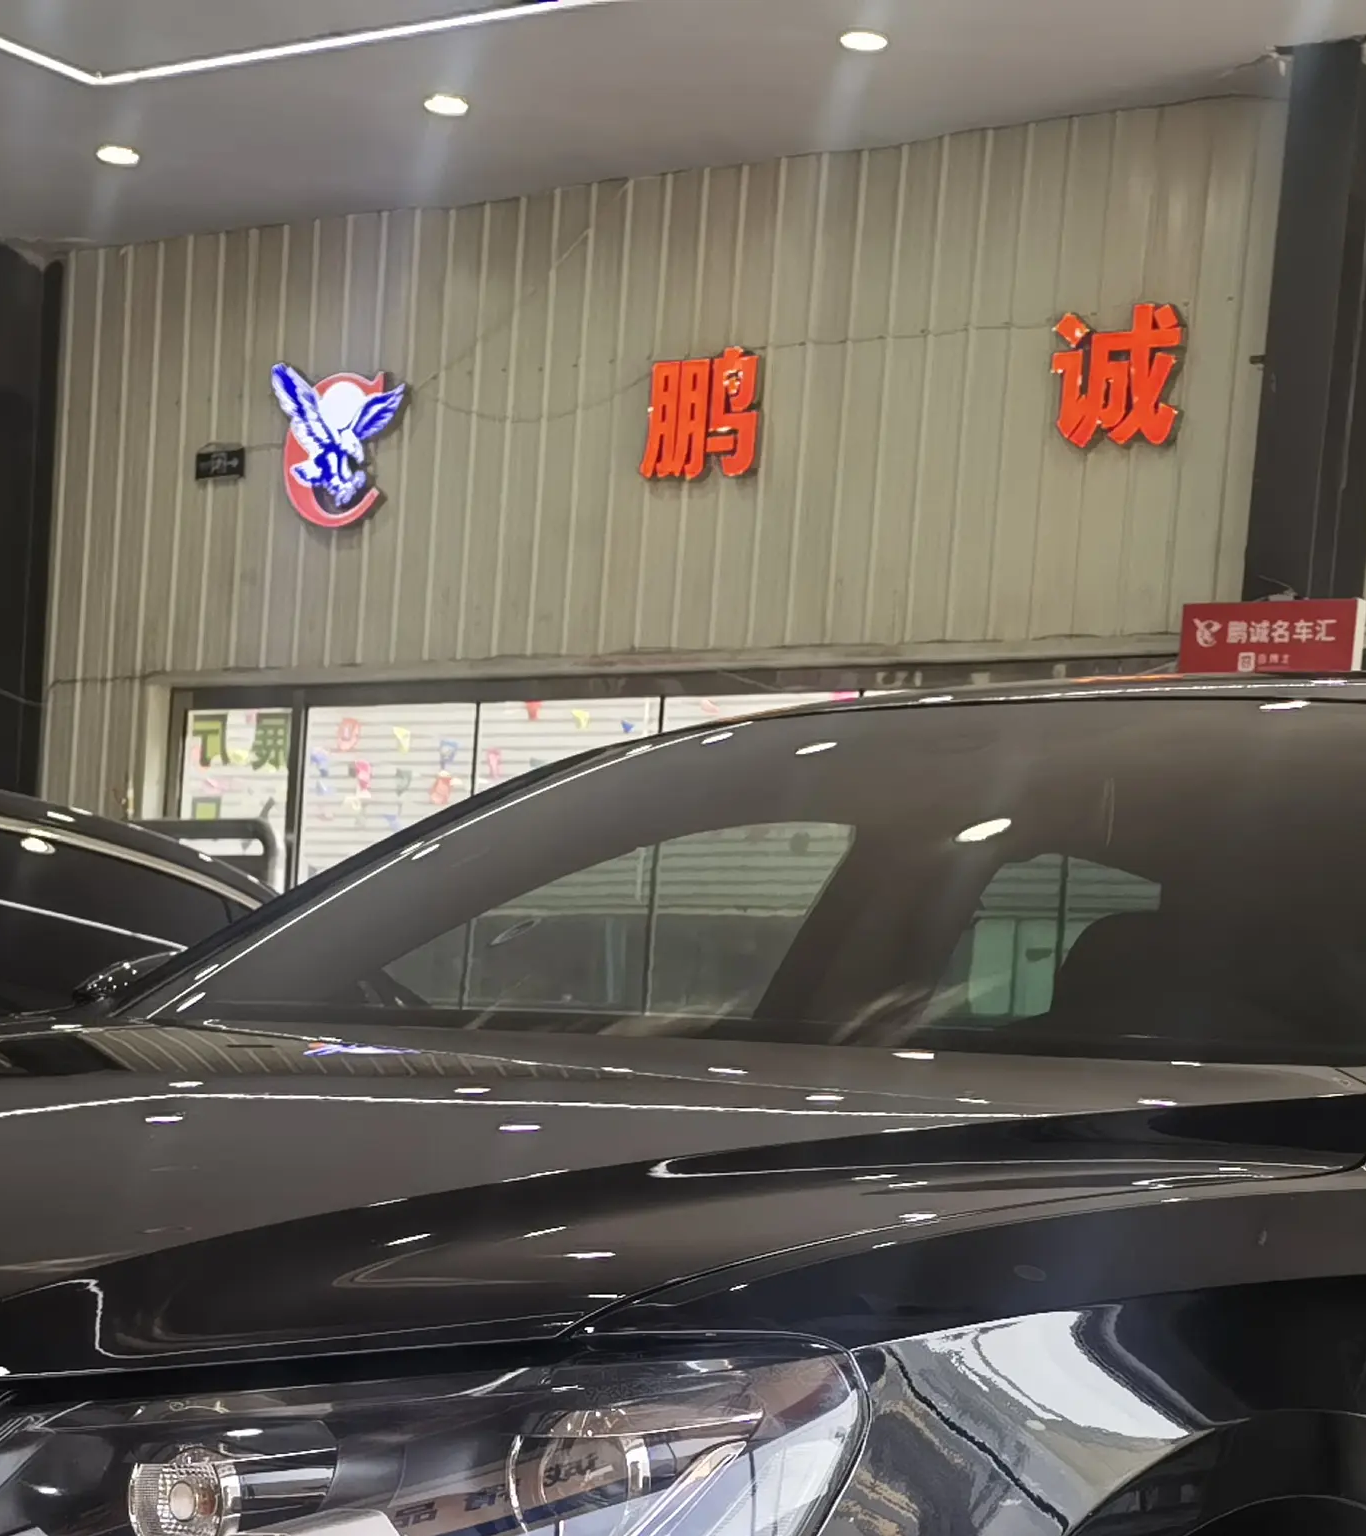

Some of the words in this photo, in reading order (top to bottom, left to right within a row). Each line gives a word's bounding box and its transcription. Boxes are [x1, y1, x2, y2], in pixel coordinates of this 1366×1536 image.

[638, 345, 759, 480] 鹏
[1051, 302, 1182, 448] 诚
[1226, 618, 1337, 645] 鹏诚名车汇
